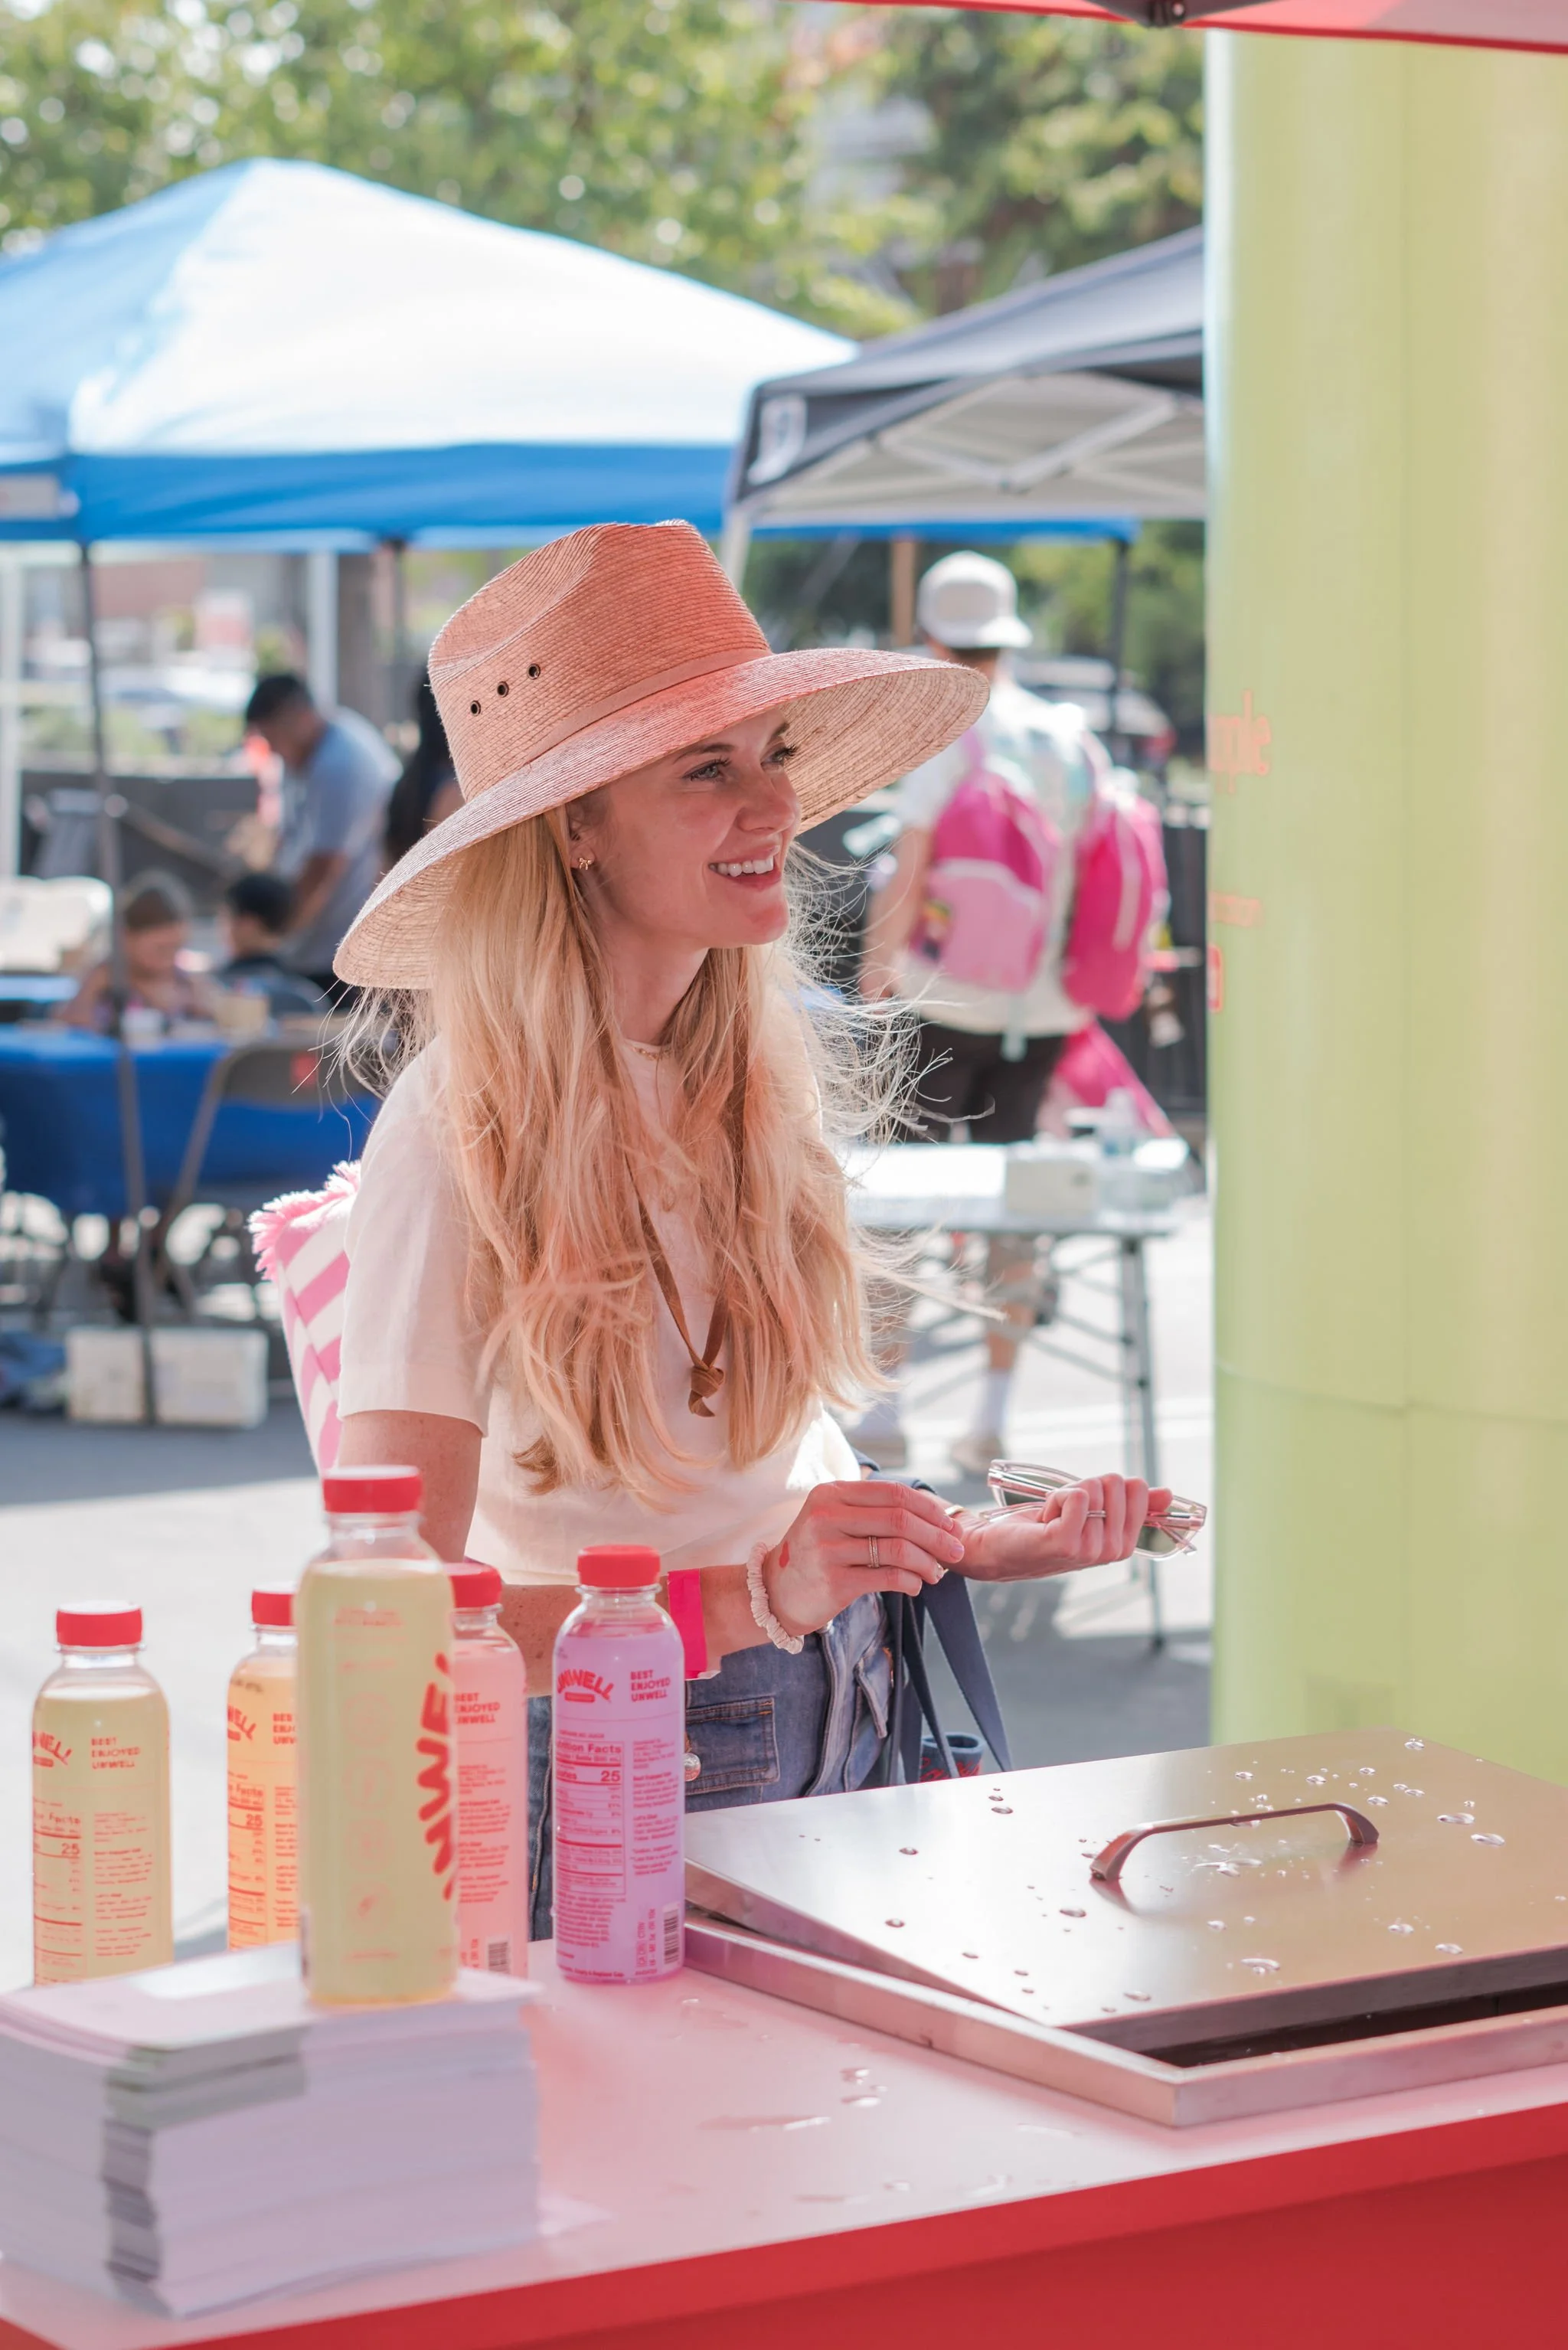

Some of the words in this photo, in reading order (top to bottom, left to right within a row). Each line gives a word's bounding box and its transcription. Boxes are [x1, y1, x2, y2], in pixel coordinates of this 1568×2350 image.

[630, 1669, 654, 1680] BEST
[630, 1677, 671, 1691] ENJOYED
[631, 1689, 668, 1701] UNWELL
[588, 1742, 622, 1754] Facts
[600, 1770, 621, 1783] 25
